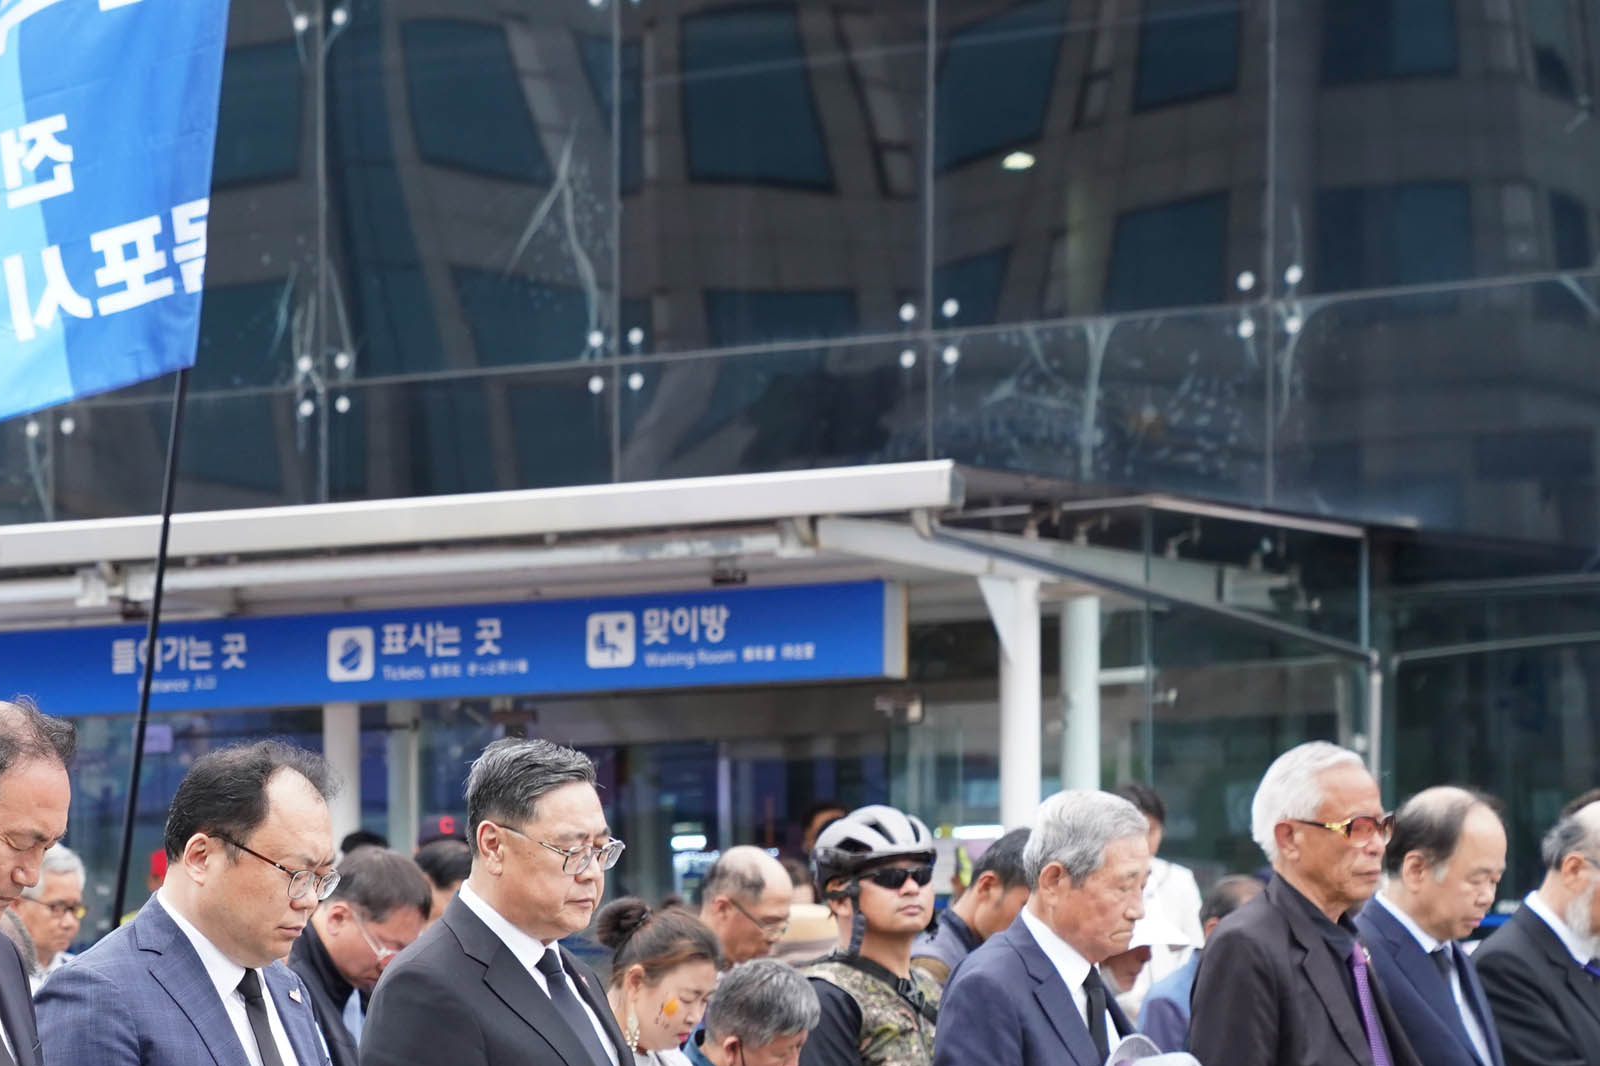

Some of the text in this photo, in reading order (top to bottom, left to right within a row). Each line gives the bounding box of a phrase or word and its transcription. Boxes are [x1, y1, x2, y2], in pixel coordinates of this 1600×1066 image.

[382, 617, 502, 657] 표사는 곳
[643, 604, 730, 646] 맞이방
[221, 632, 247, 670] 곳
